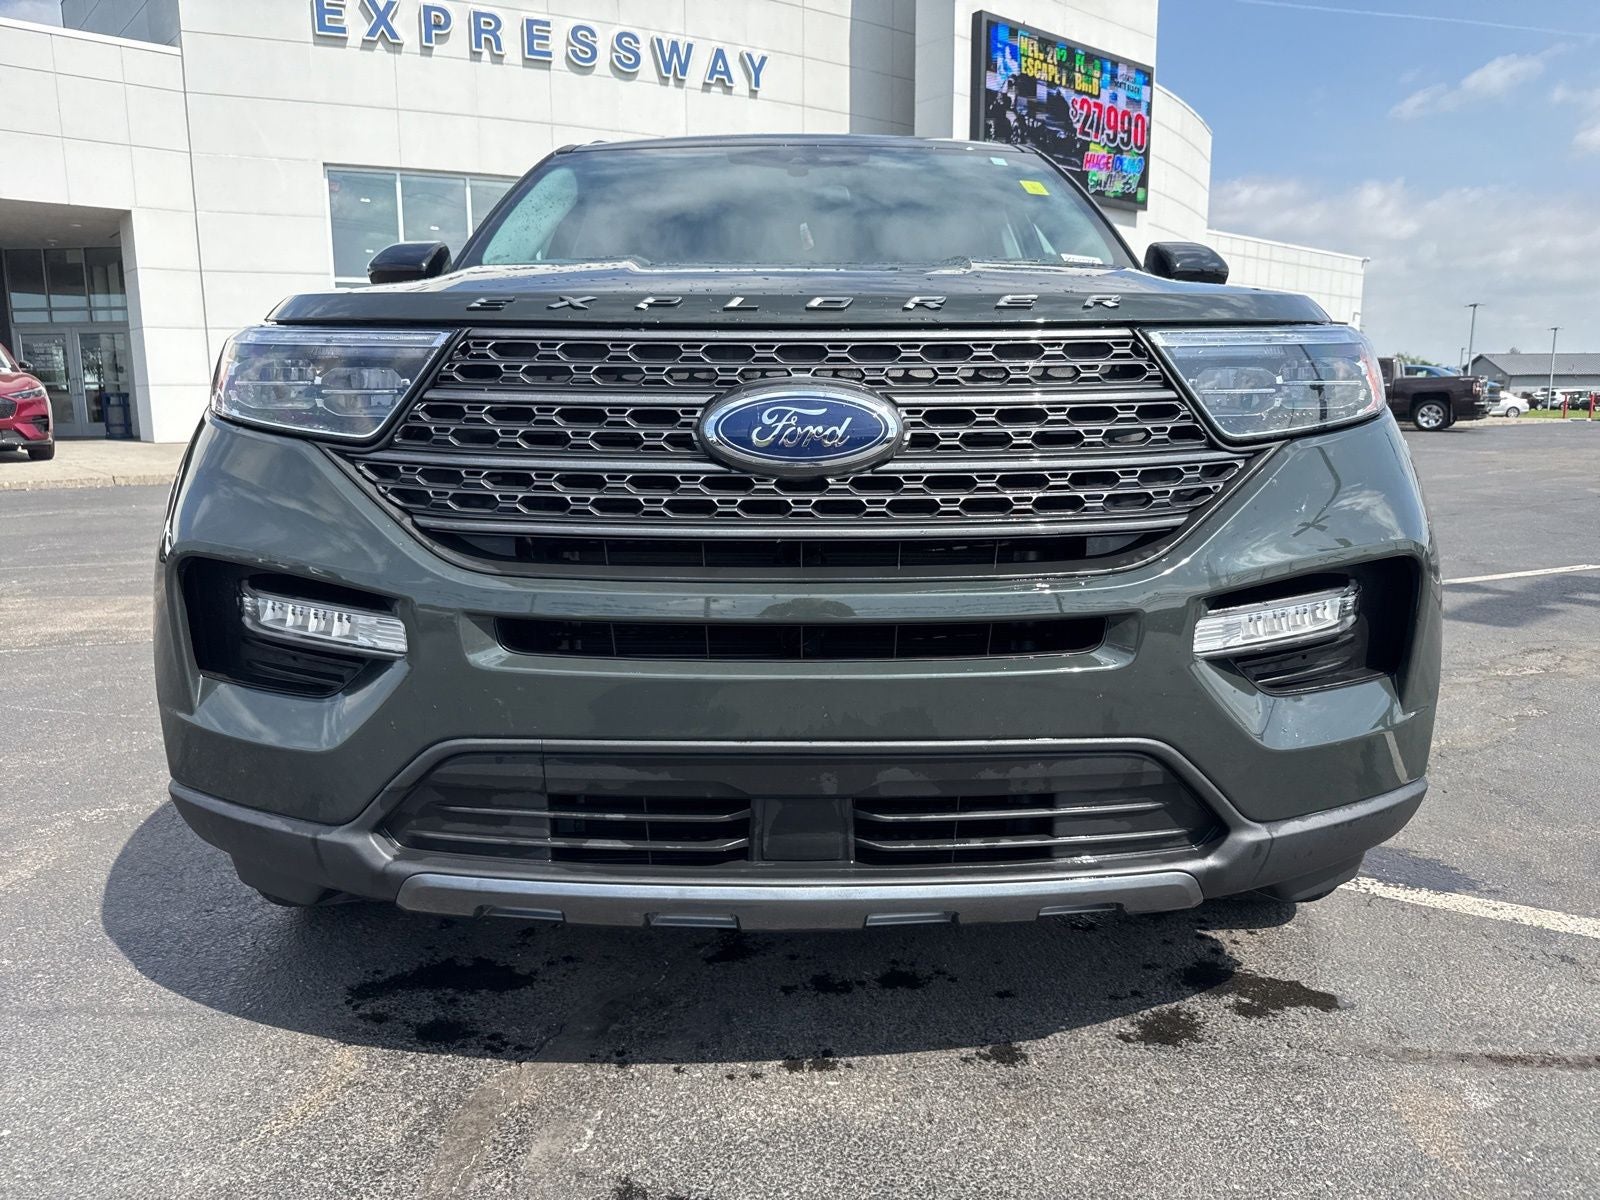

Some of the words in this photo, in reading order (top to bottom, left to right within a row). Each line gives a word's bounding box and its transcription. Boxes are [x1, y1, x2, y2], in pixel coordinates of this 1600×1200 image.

[312, 0, 768, 94] EXPRESSWAY
[1070, 96, 1146, 153] $27,990
[1083, 152, 1113, 172] HUGE
[466, 294, 1121, 312] EXPLORER
[752, 406, 852, 447] Ford
